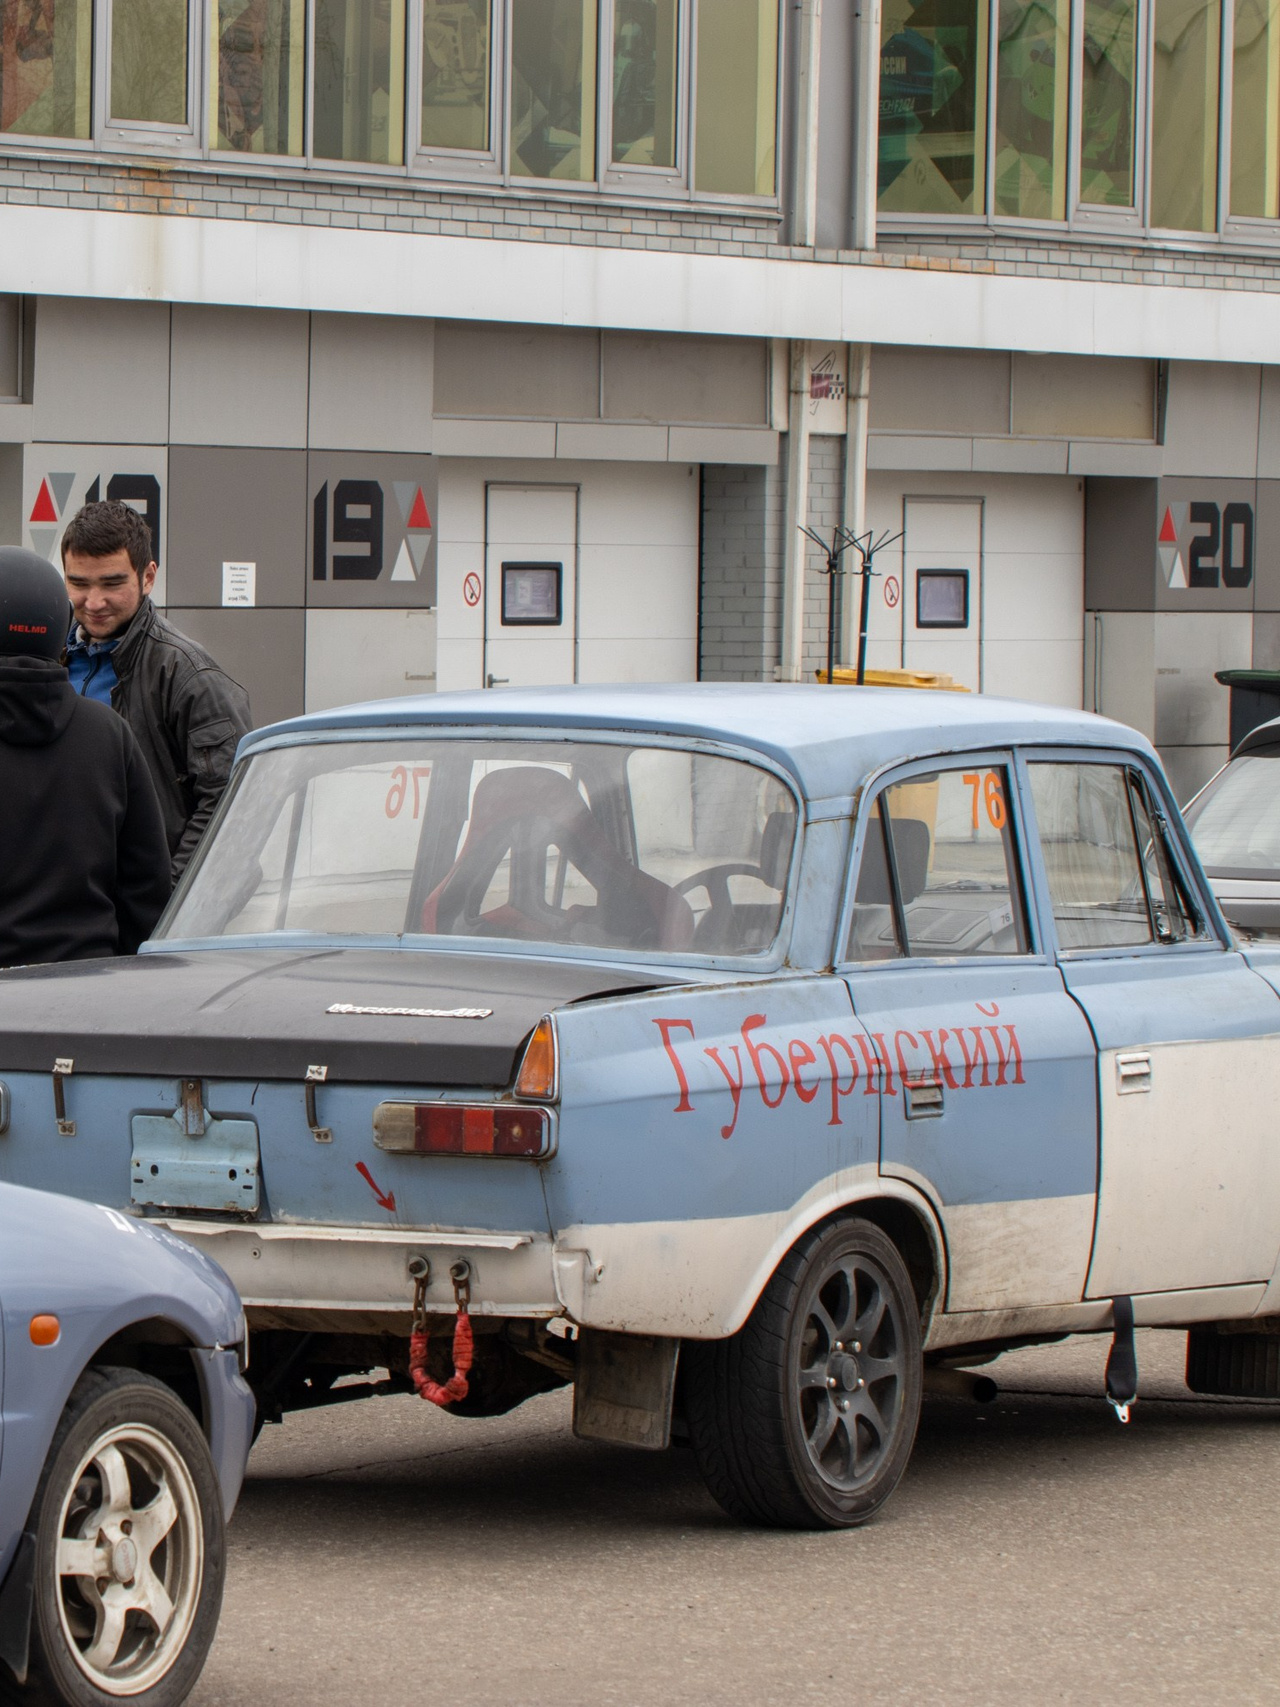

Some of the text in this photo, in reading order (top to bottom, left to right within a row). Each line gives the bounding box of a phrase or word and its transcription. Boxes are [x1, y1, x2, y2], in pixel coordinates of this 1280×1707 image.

[313, 479, 384, 581] 19
[1188, 502, 1254, 588] 20
[9, 624, 47, 634] HELMO
[962, 772, 1007, 830] 76
[652, 1002, 1026, 1140] Губернский
